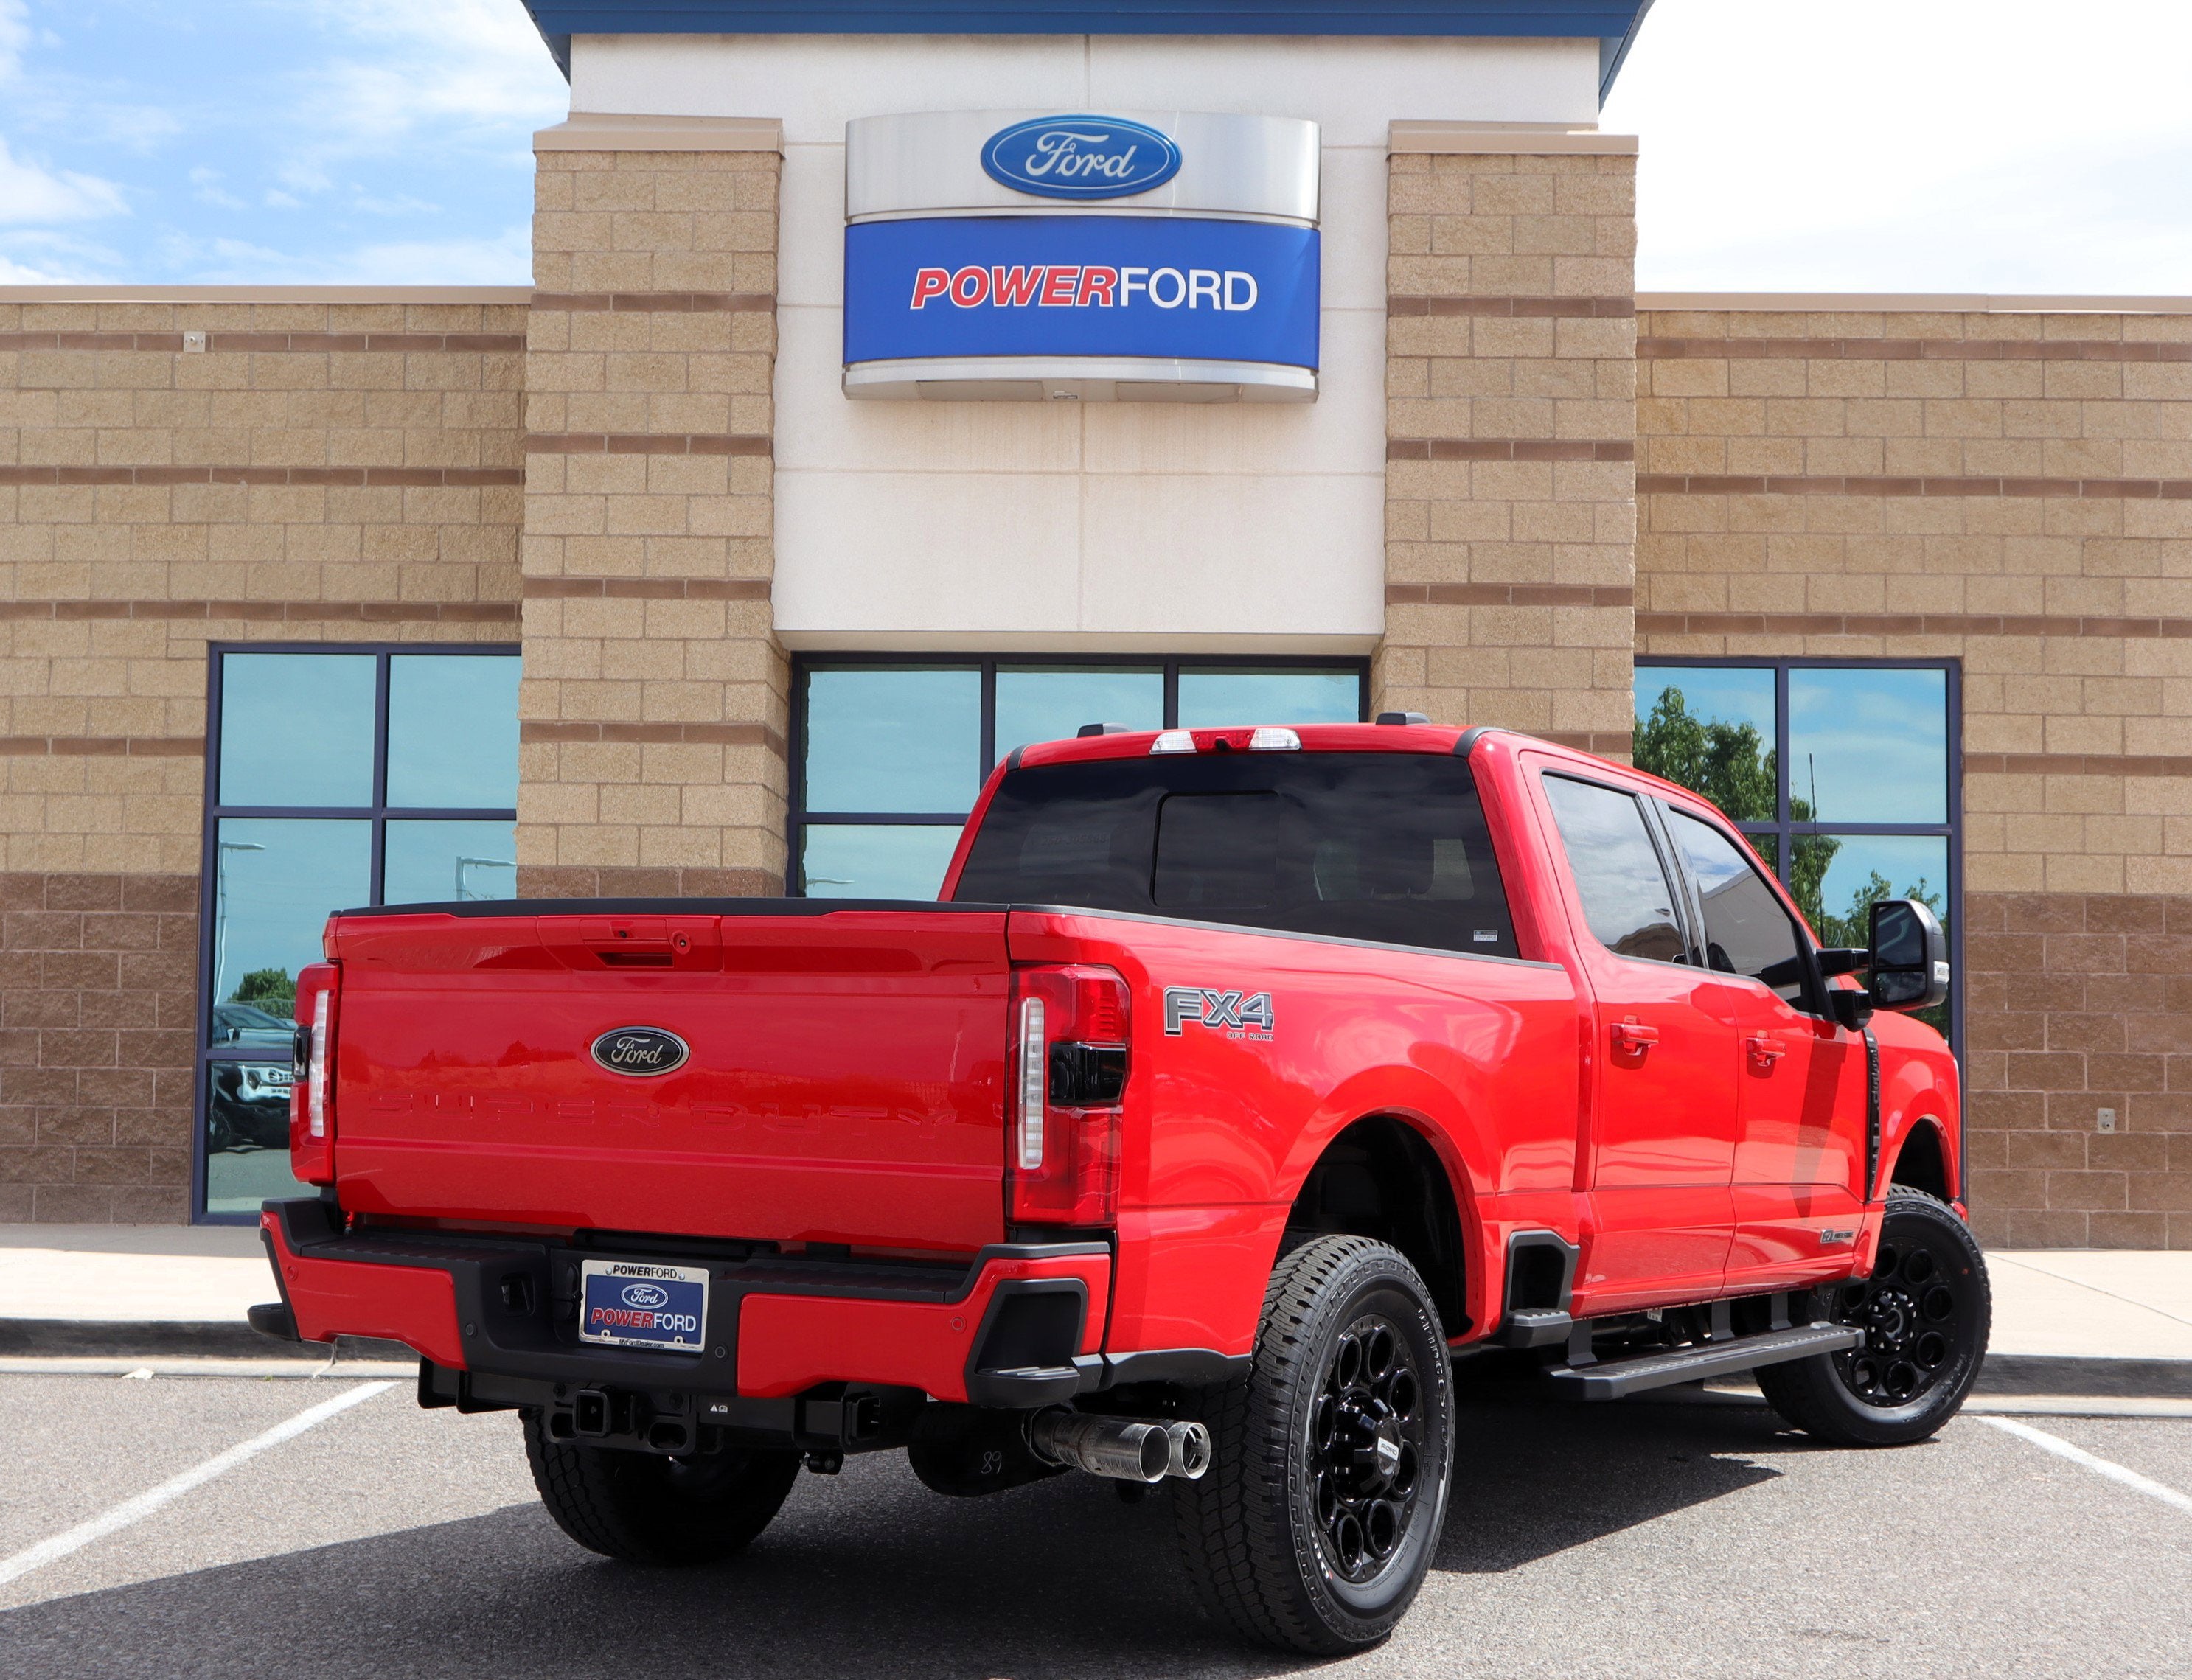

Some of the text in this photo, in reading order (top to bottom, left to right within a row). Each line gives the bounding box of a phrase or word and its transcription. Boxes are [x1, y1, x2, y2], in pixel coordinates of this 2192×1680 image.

[1025, 130, 1137, 179] Ford
[910, 265, 1257, 311] POWERFORD
[1163, 986, 1273, 1036] FX4
[1249, 1034, 1273, 1042] ROAD
[610, 1036, 664, 1066] Ford
[368, 1091, 958, 1138] SUPER DUTY
[613, 1265, 677, 1279] POWERFORD
[630, 1289, 658, 1305] Ford
[591, 1308, 695, 1332] POWERFORD
[1380, 1443, 1397, 1456] FORD
[981, 1451, 1001, 1474] 89
